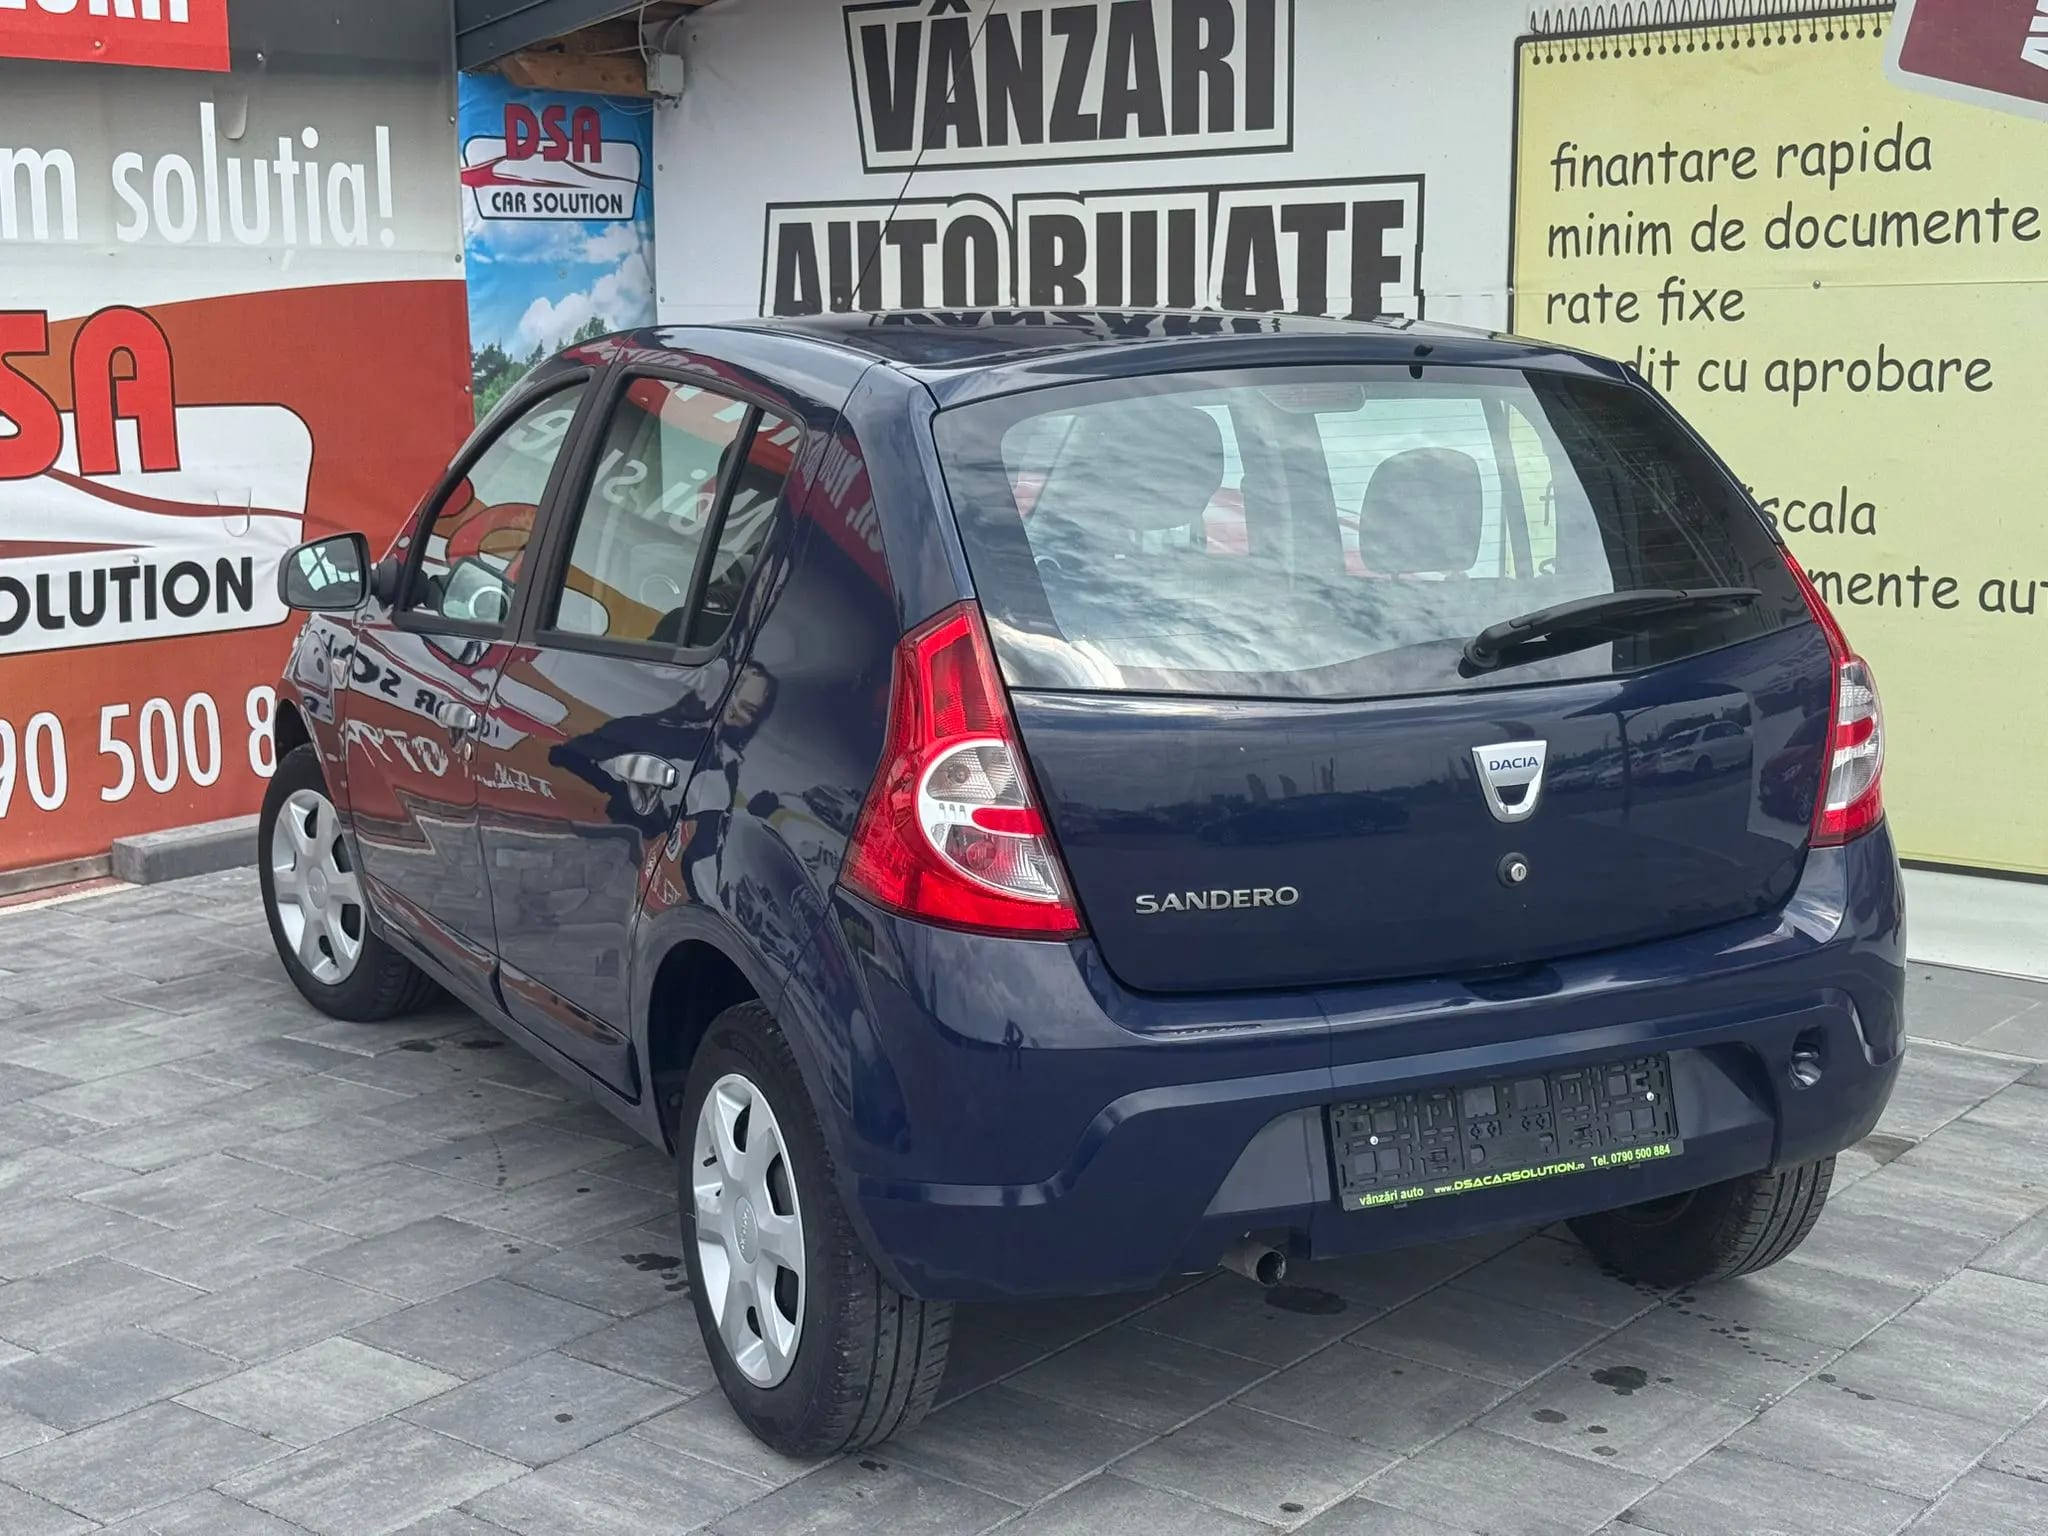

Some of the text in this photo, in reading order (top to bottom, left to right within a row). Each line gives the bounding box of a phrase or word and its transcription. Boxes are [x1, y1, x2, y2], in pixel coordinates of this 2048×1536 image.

[860, 0, 1275, 152] VÂNZARI
[504, 103, 602, 163] DSA
[1550, 120, 1932, 192] finantare rapida
[491, 191, 623, 214] CAR SOLUTION
[1548, 197, 2041, 259] minim de documente
[1546, 276, 1746, 326] rate fixe
[1697, 359, 1747, 393] cu
[1764, 343, 1994, 407] aprobare
[98, 691, 223, 804] 500
[1489, 756, 1539, 771] DACIA
[1135, 886, 1299, 915] SANDERO
[1400, 1186, 1425, 1200] auto
[1591, 1155, 1610, 1168] Tel.
[1611, 1150, 1634, 1164] 0790
[1635, 1146, 1652, 1160] 500
[1653, 1143, 1671, 1157] 884
